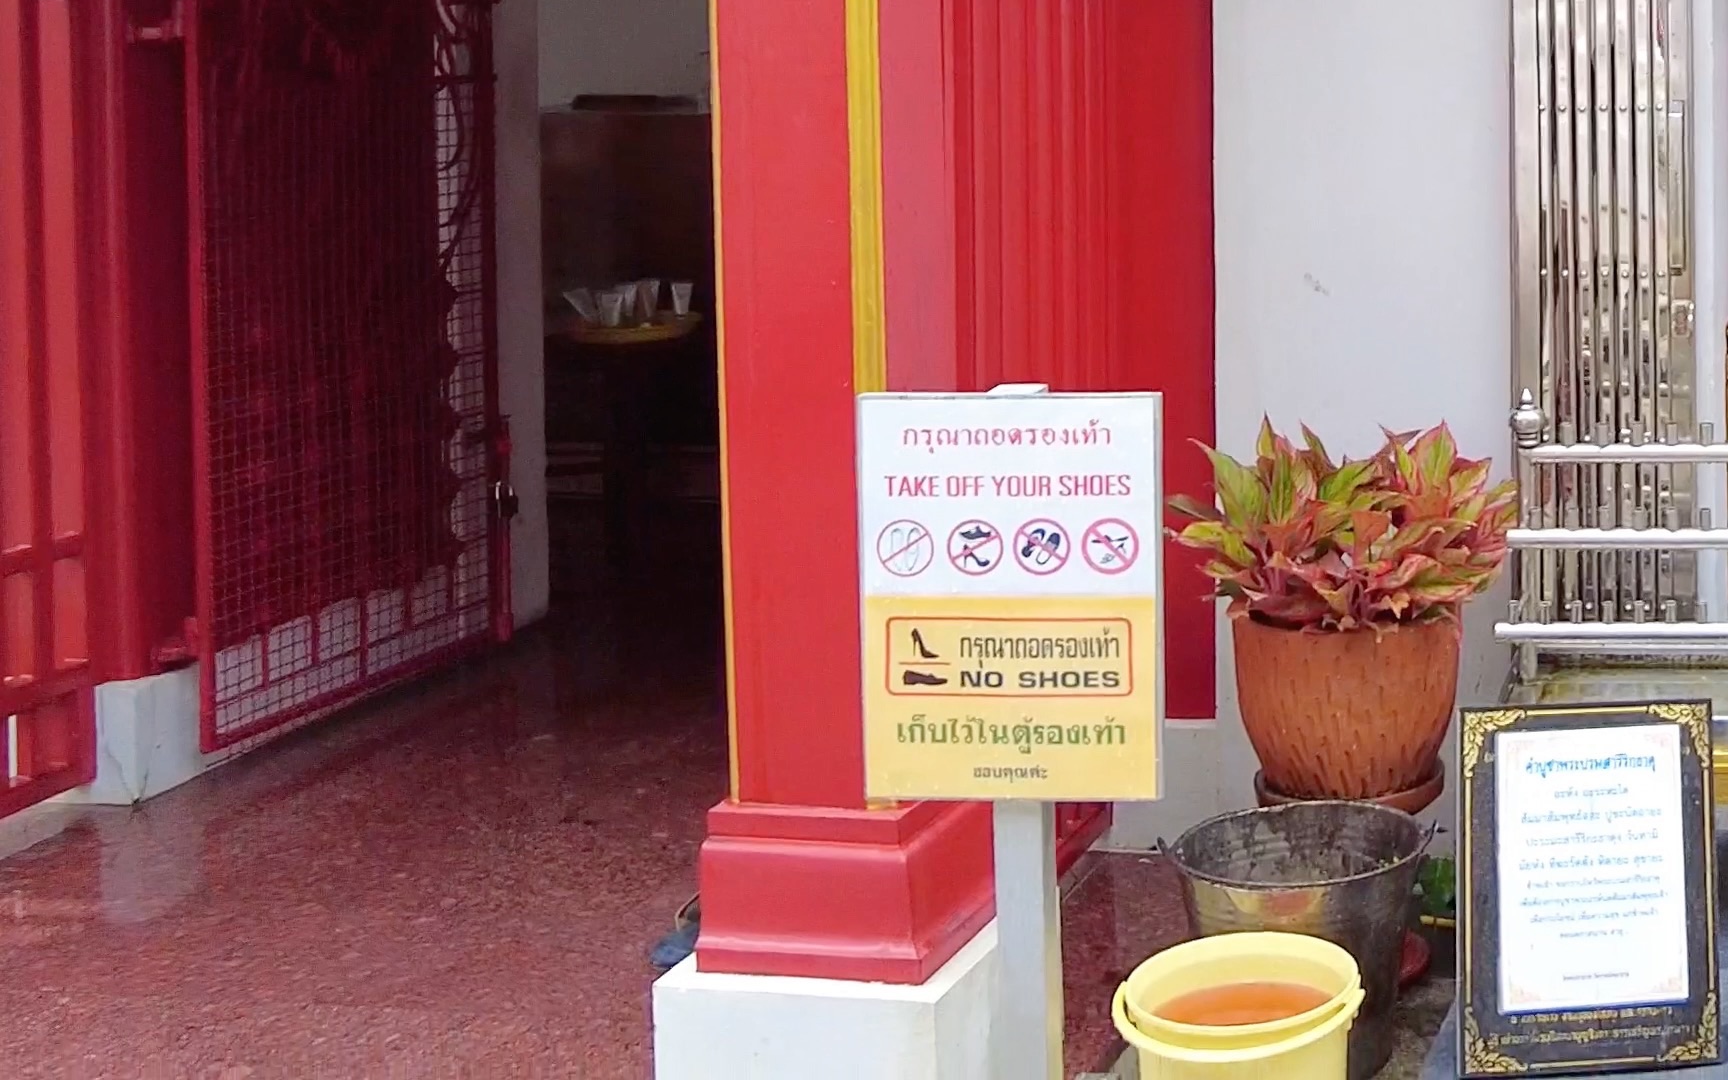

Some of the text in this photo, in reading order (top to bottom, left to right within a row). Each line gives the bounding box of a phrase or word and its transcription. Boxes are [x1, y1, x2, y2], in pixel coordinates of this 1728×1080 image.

[903, 419, 1111, 454] กรุณาถอดรองเท้า
[884, 474, 1131, 497] TAKE OFF YOUR SHOES
[959, 626, 1121, 669] กรุณาถอดรองเท้า
[960, 671, 1121, 689] NO SHOES
[897, 713, 1126, 755] เก็บไว้ในตู้รองเท้า
